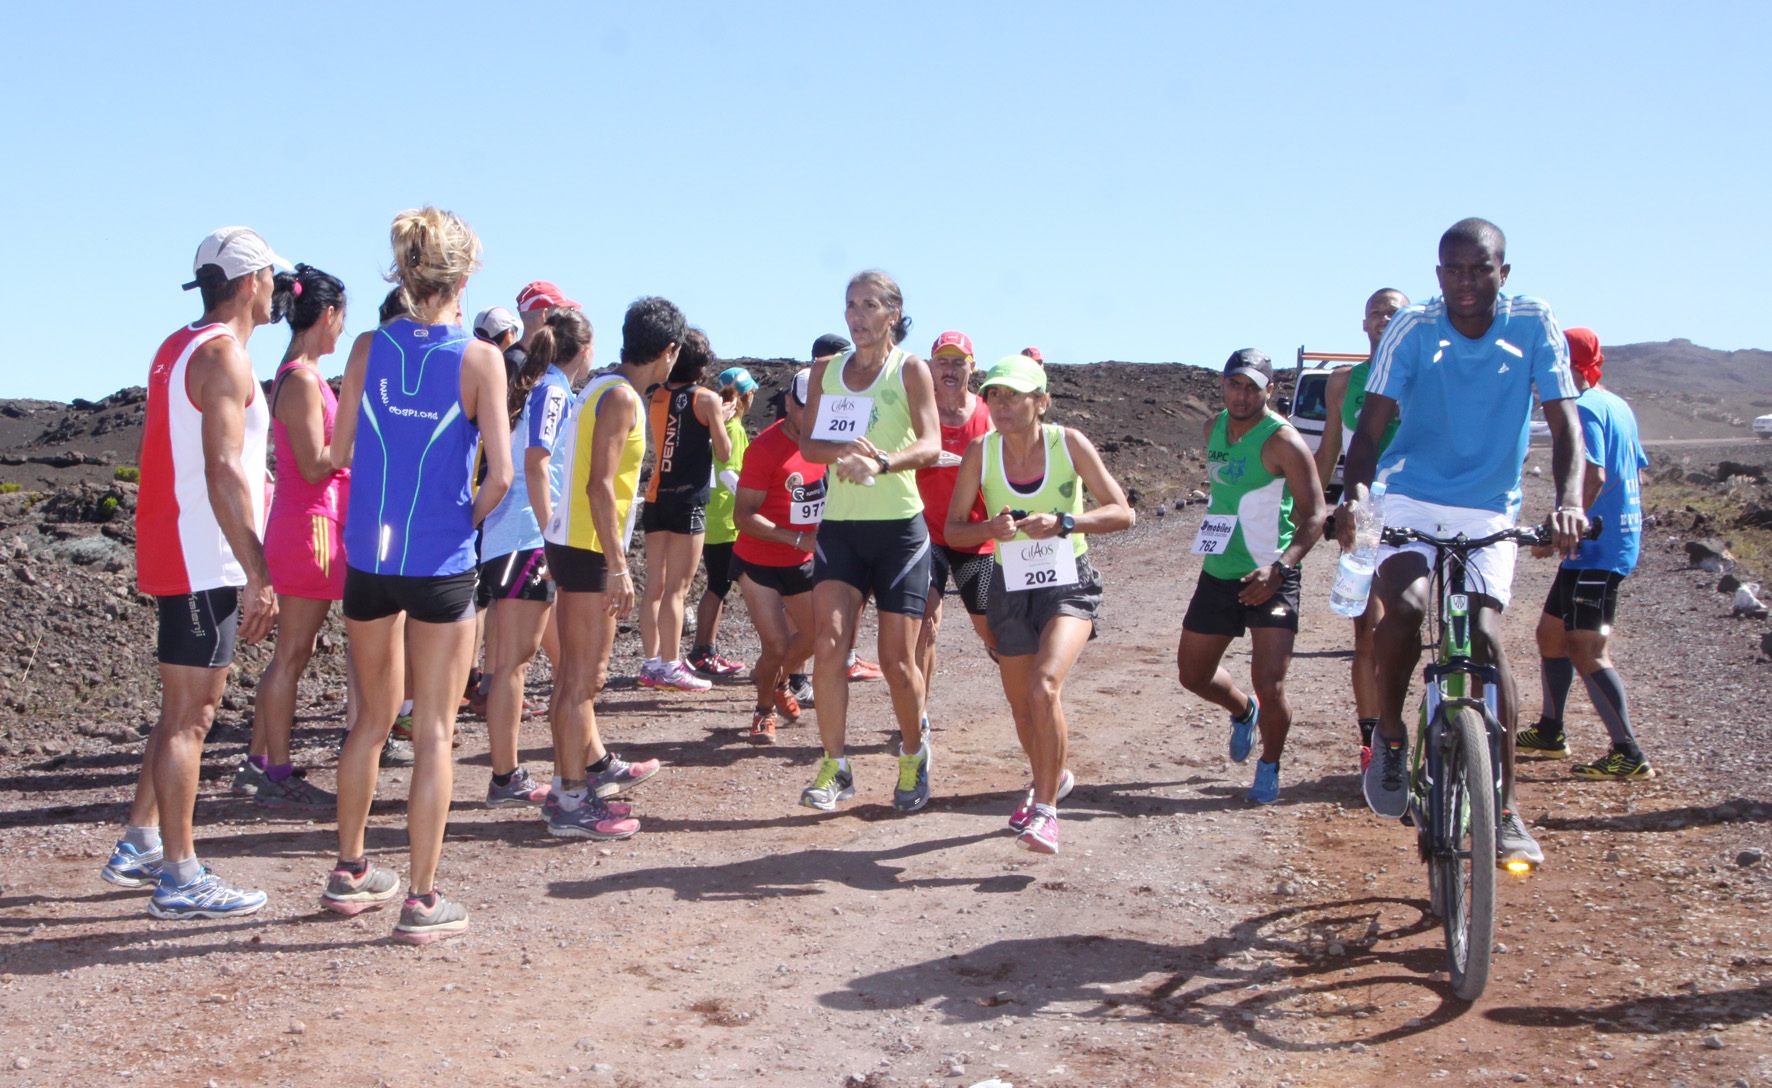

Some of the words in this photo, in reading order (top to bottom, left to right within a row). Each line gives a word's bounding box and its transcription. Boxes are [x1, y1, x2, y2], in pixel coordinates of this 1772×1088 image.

[829, 419, 856, 432] 201
[1199, 540, 1218, 553] 762
[1024, 569, 1058, 586] 202
